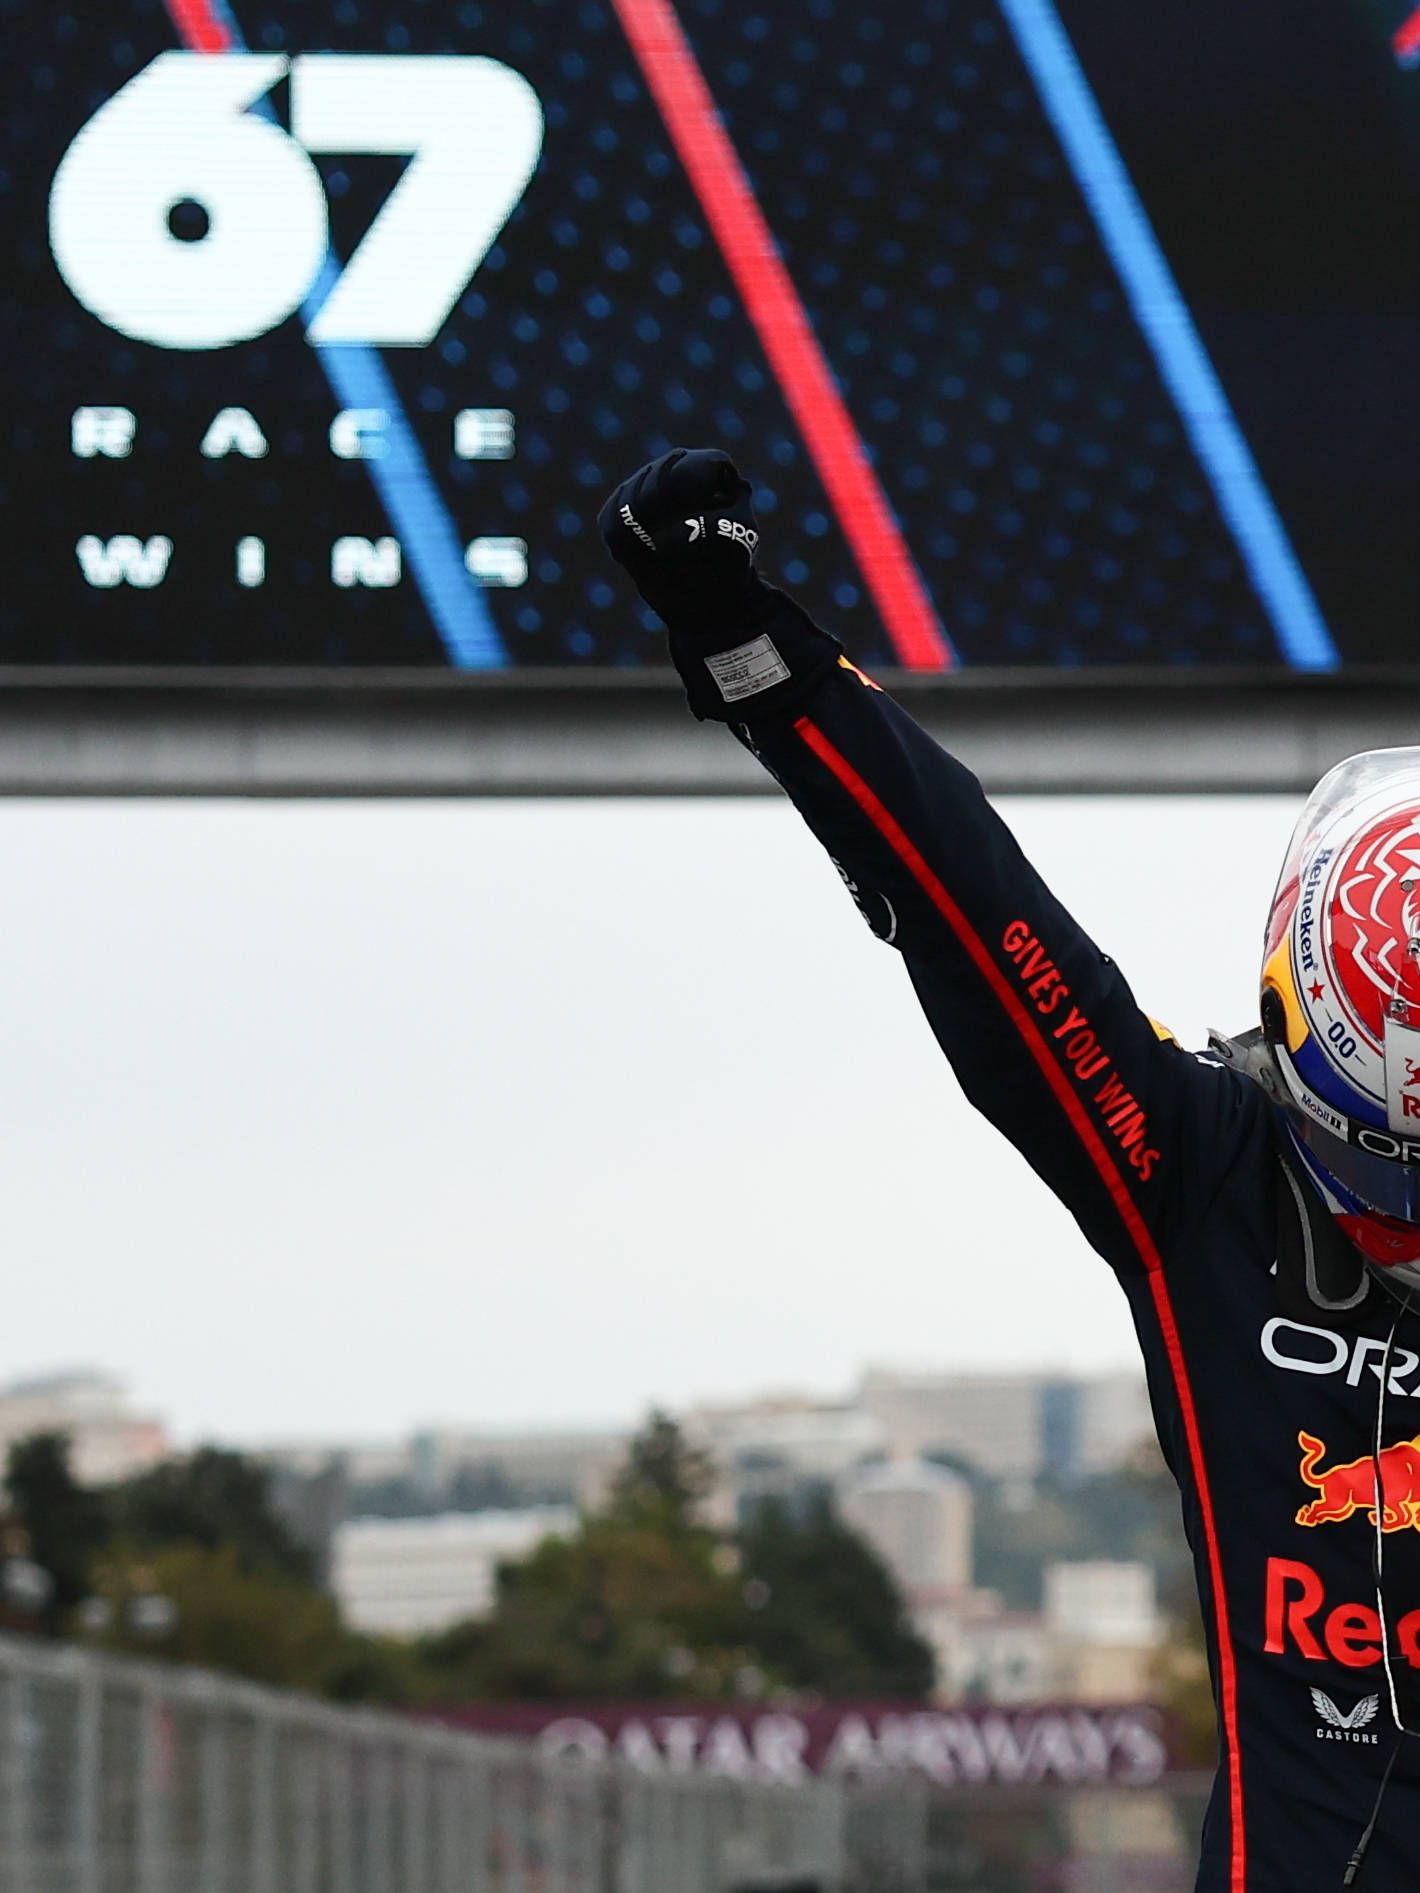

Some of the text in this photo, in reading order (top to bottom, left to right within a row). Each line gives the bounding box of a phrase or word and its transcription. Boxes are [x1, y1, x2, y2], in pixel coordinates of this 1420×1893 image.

[49, 51, 545, 351] 67
[71, 406, 517, 459] RACE
[76, 534, 528, 588] WINS
[1300, 847, 1333, 972] Heineken
[1003, 919, 1070, 1014] GIVES
[1053, 1005, 1110, 1080] YOU
[1302, 1093, 1330, 1122] Mobil
[1315, 1728, 1379, 1745] CASTORE
